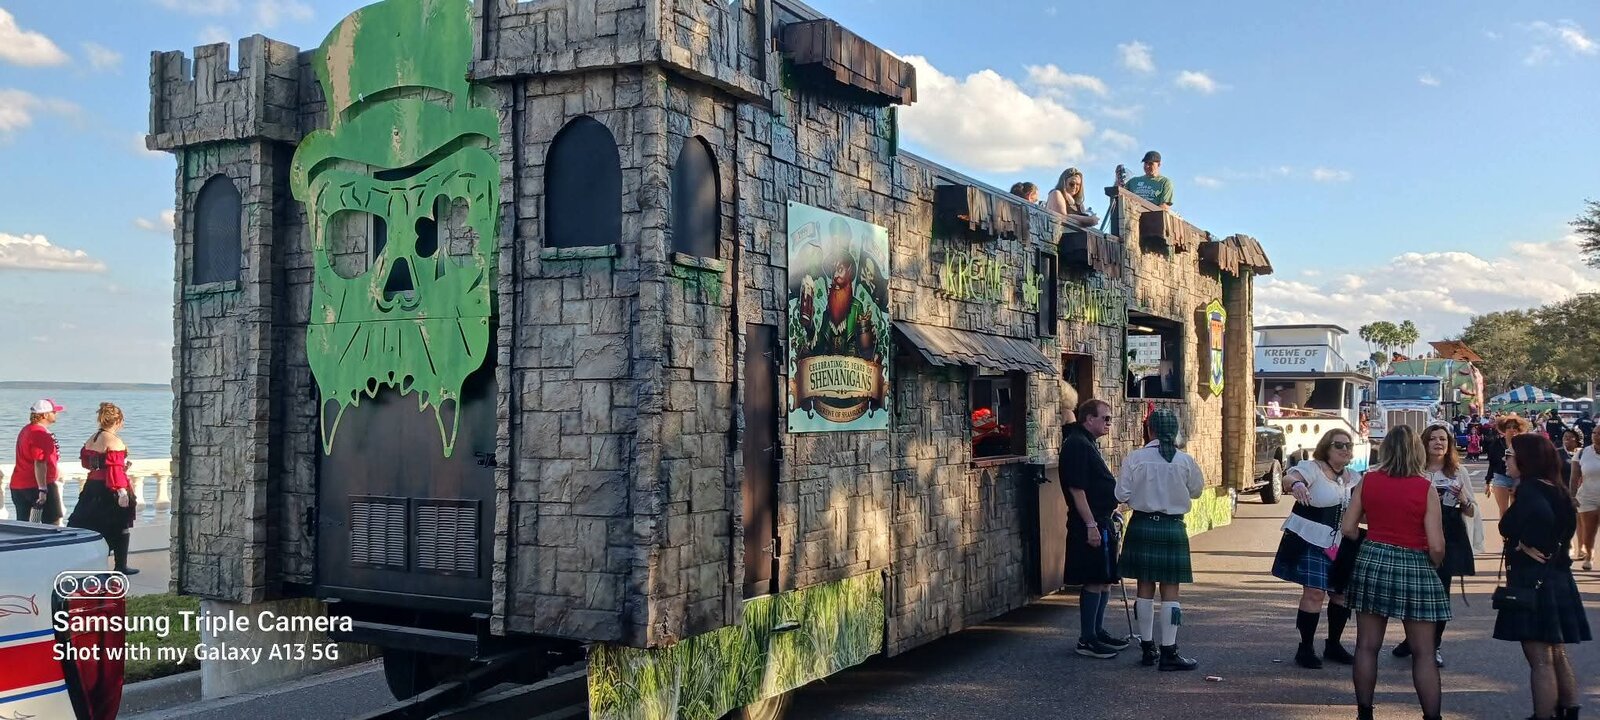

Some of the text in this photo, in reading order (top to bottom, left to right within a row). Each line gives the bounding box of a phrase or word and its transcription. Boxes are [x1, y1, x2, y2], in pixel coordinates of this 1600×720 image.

[1264, 349, 1319, 357] KREWE OF
[1272, 357, 1307, 365] SOLIS
[809, 360, 873, 374] CELEBRATING 25 YEARS OF
[809, 369, 872, 391] SHENANIGANS
